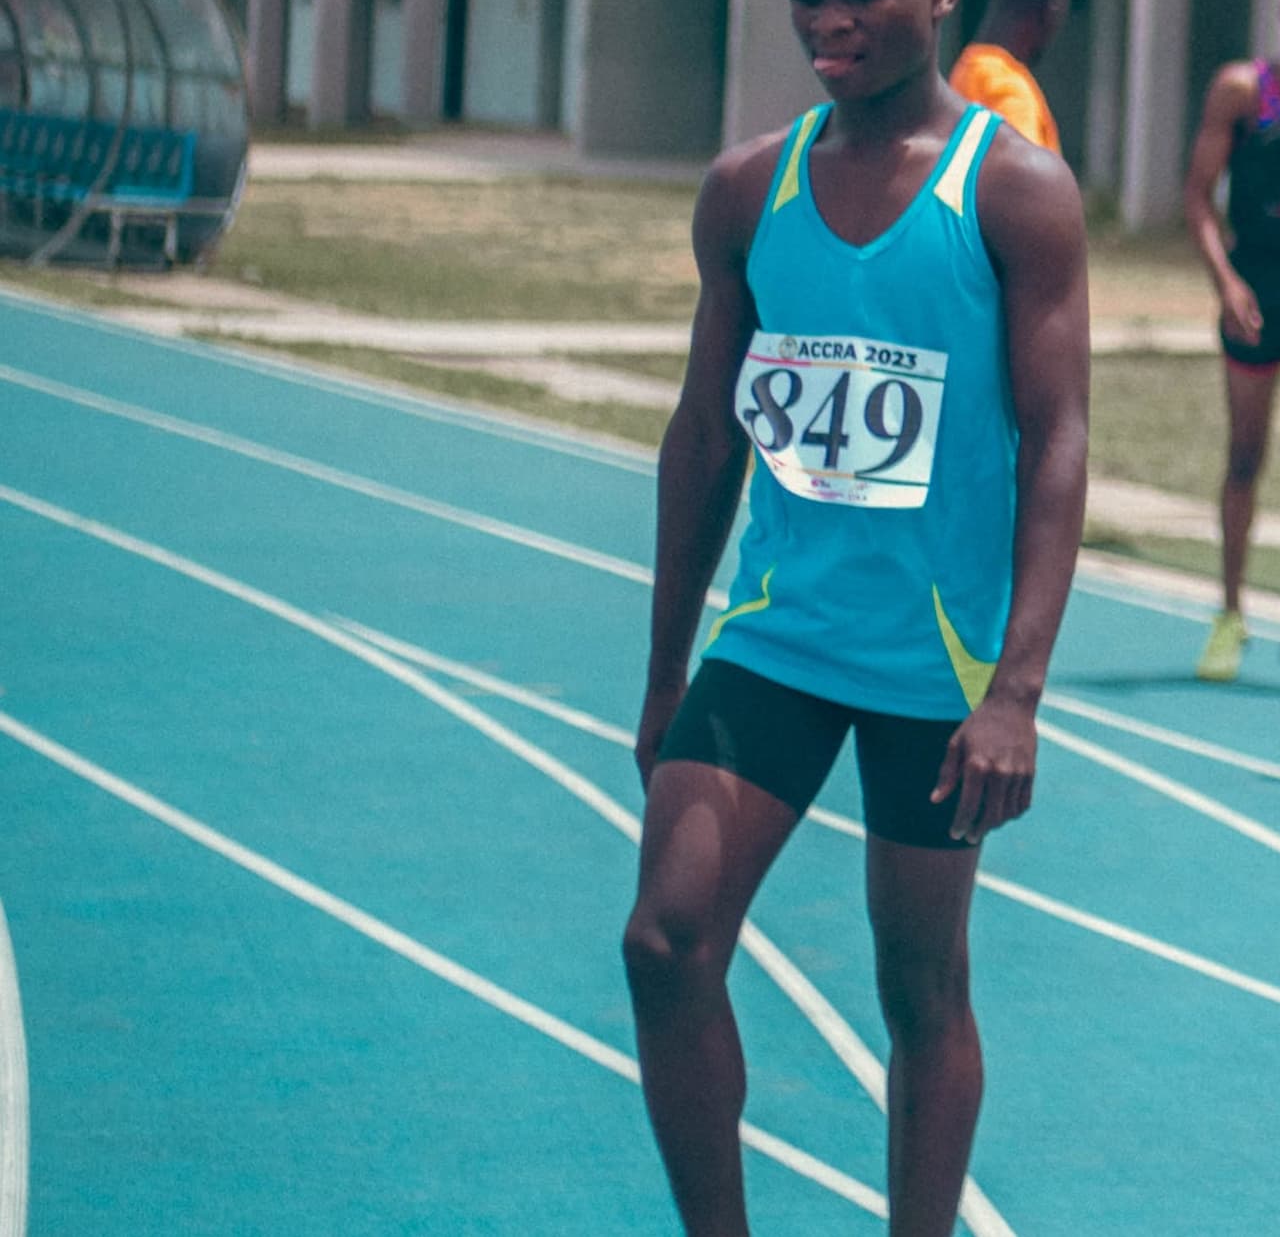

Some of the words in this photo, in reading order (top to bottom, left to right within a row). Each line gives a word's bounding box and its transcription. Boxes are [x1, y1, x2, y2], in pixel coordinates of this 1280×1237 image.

[797, 342, 857, 361] ACCRA
[864, 345, 919, 370] 2023
[742, 368, 924, 476] 849
